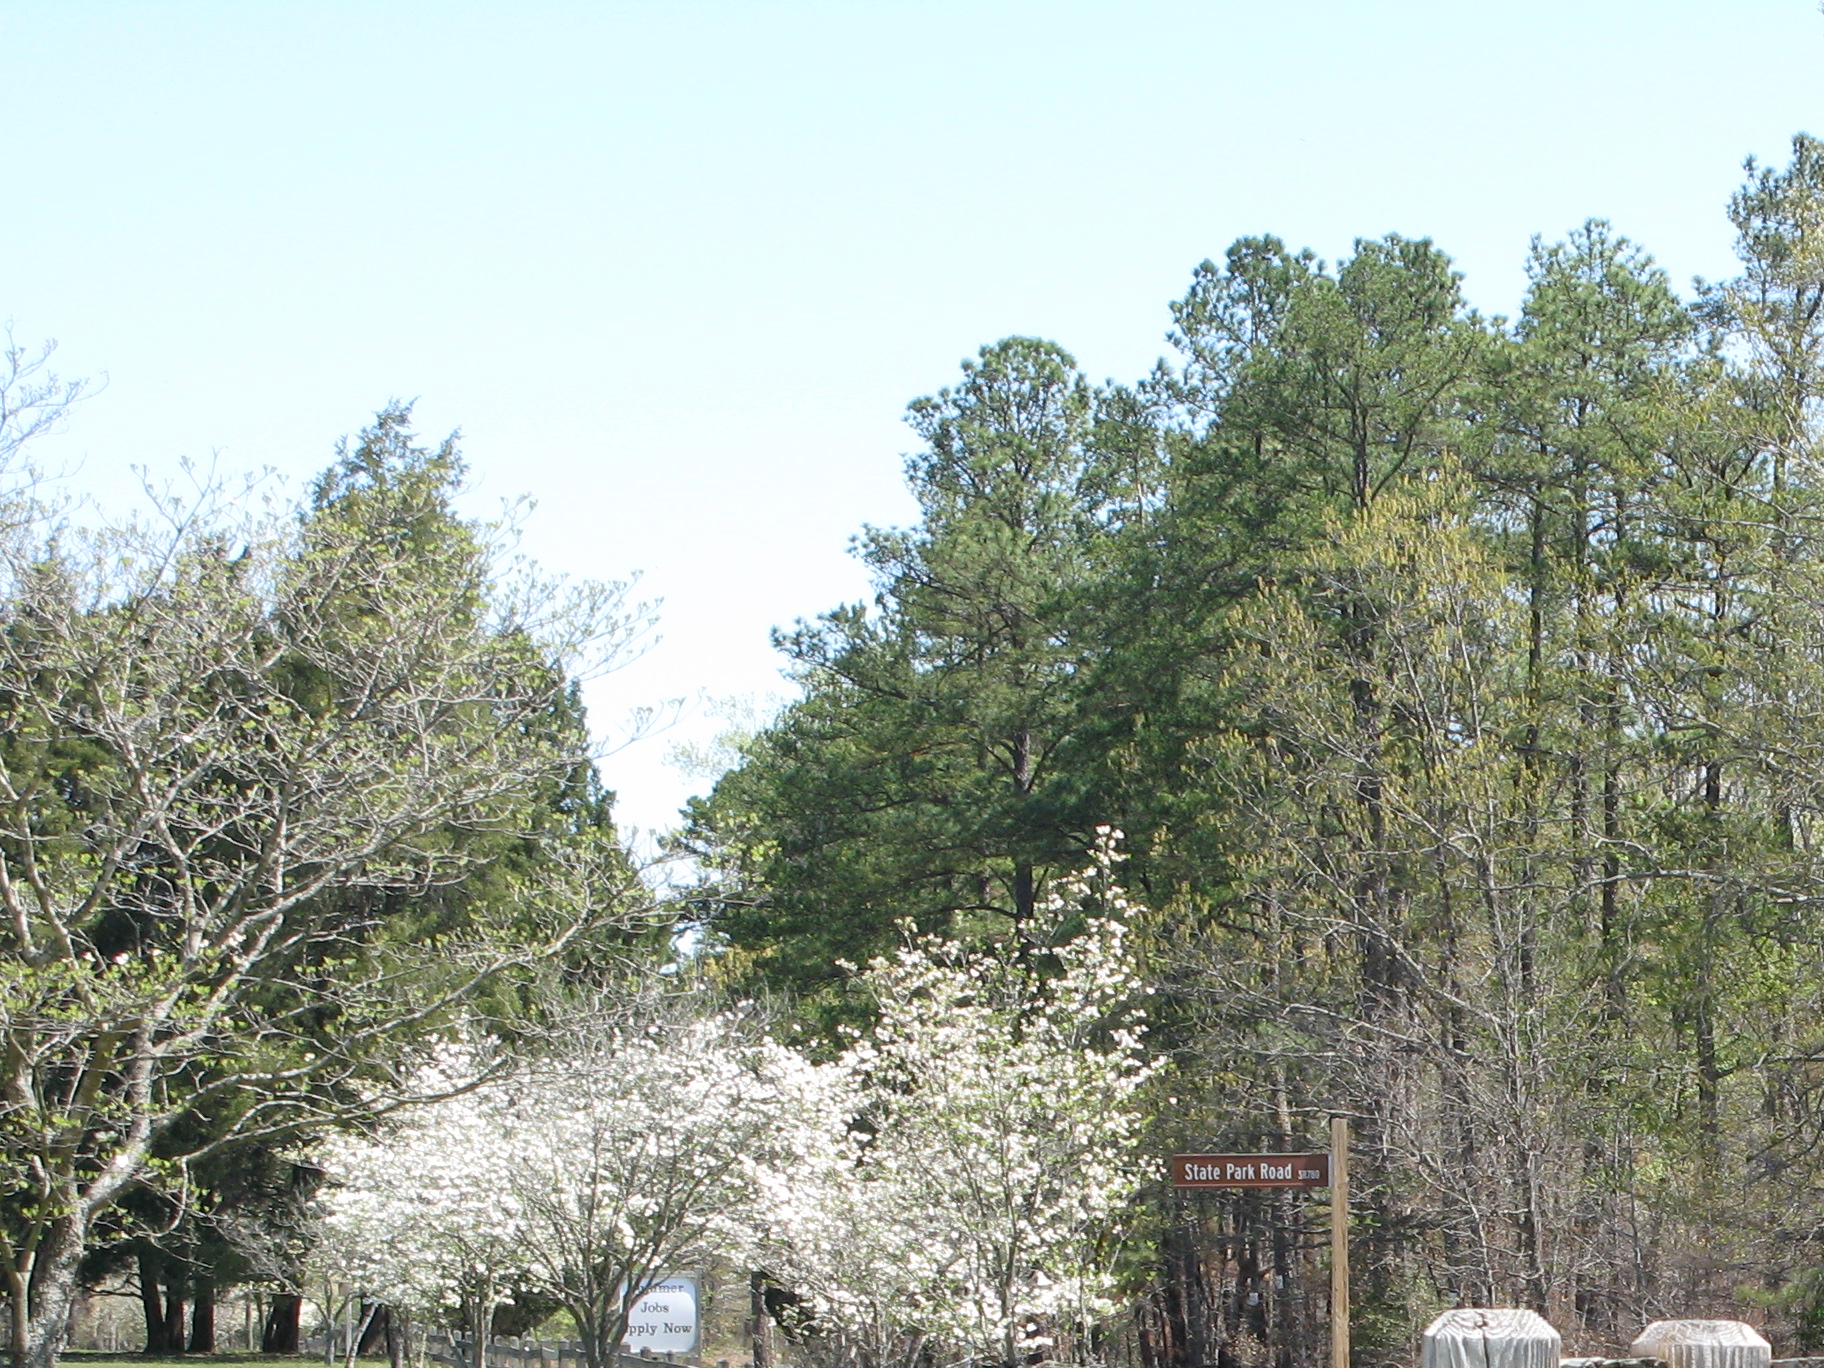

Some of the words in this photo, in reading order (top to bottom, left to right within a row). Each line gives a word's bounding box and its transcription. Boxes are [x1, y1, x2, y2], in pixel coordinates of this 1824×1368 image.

[1184, 1163, 1221, 1181] State
[1226, 1163, 1255, 1180] Park
[1260, 1162, 1292, 1180] Road
[640, 1302, 670, 1313] Jobs
[627, 1322, 658, 1337] pply
[663, 1322, 693, 1334] Now
